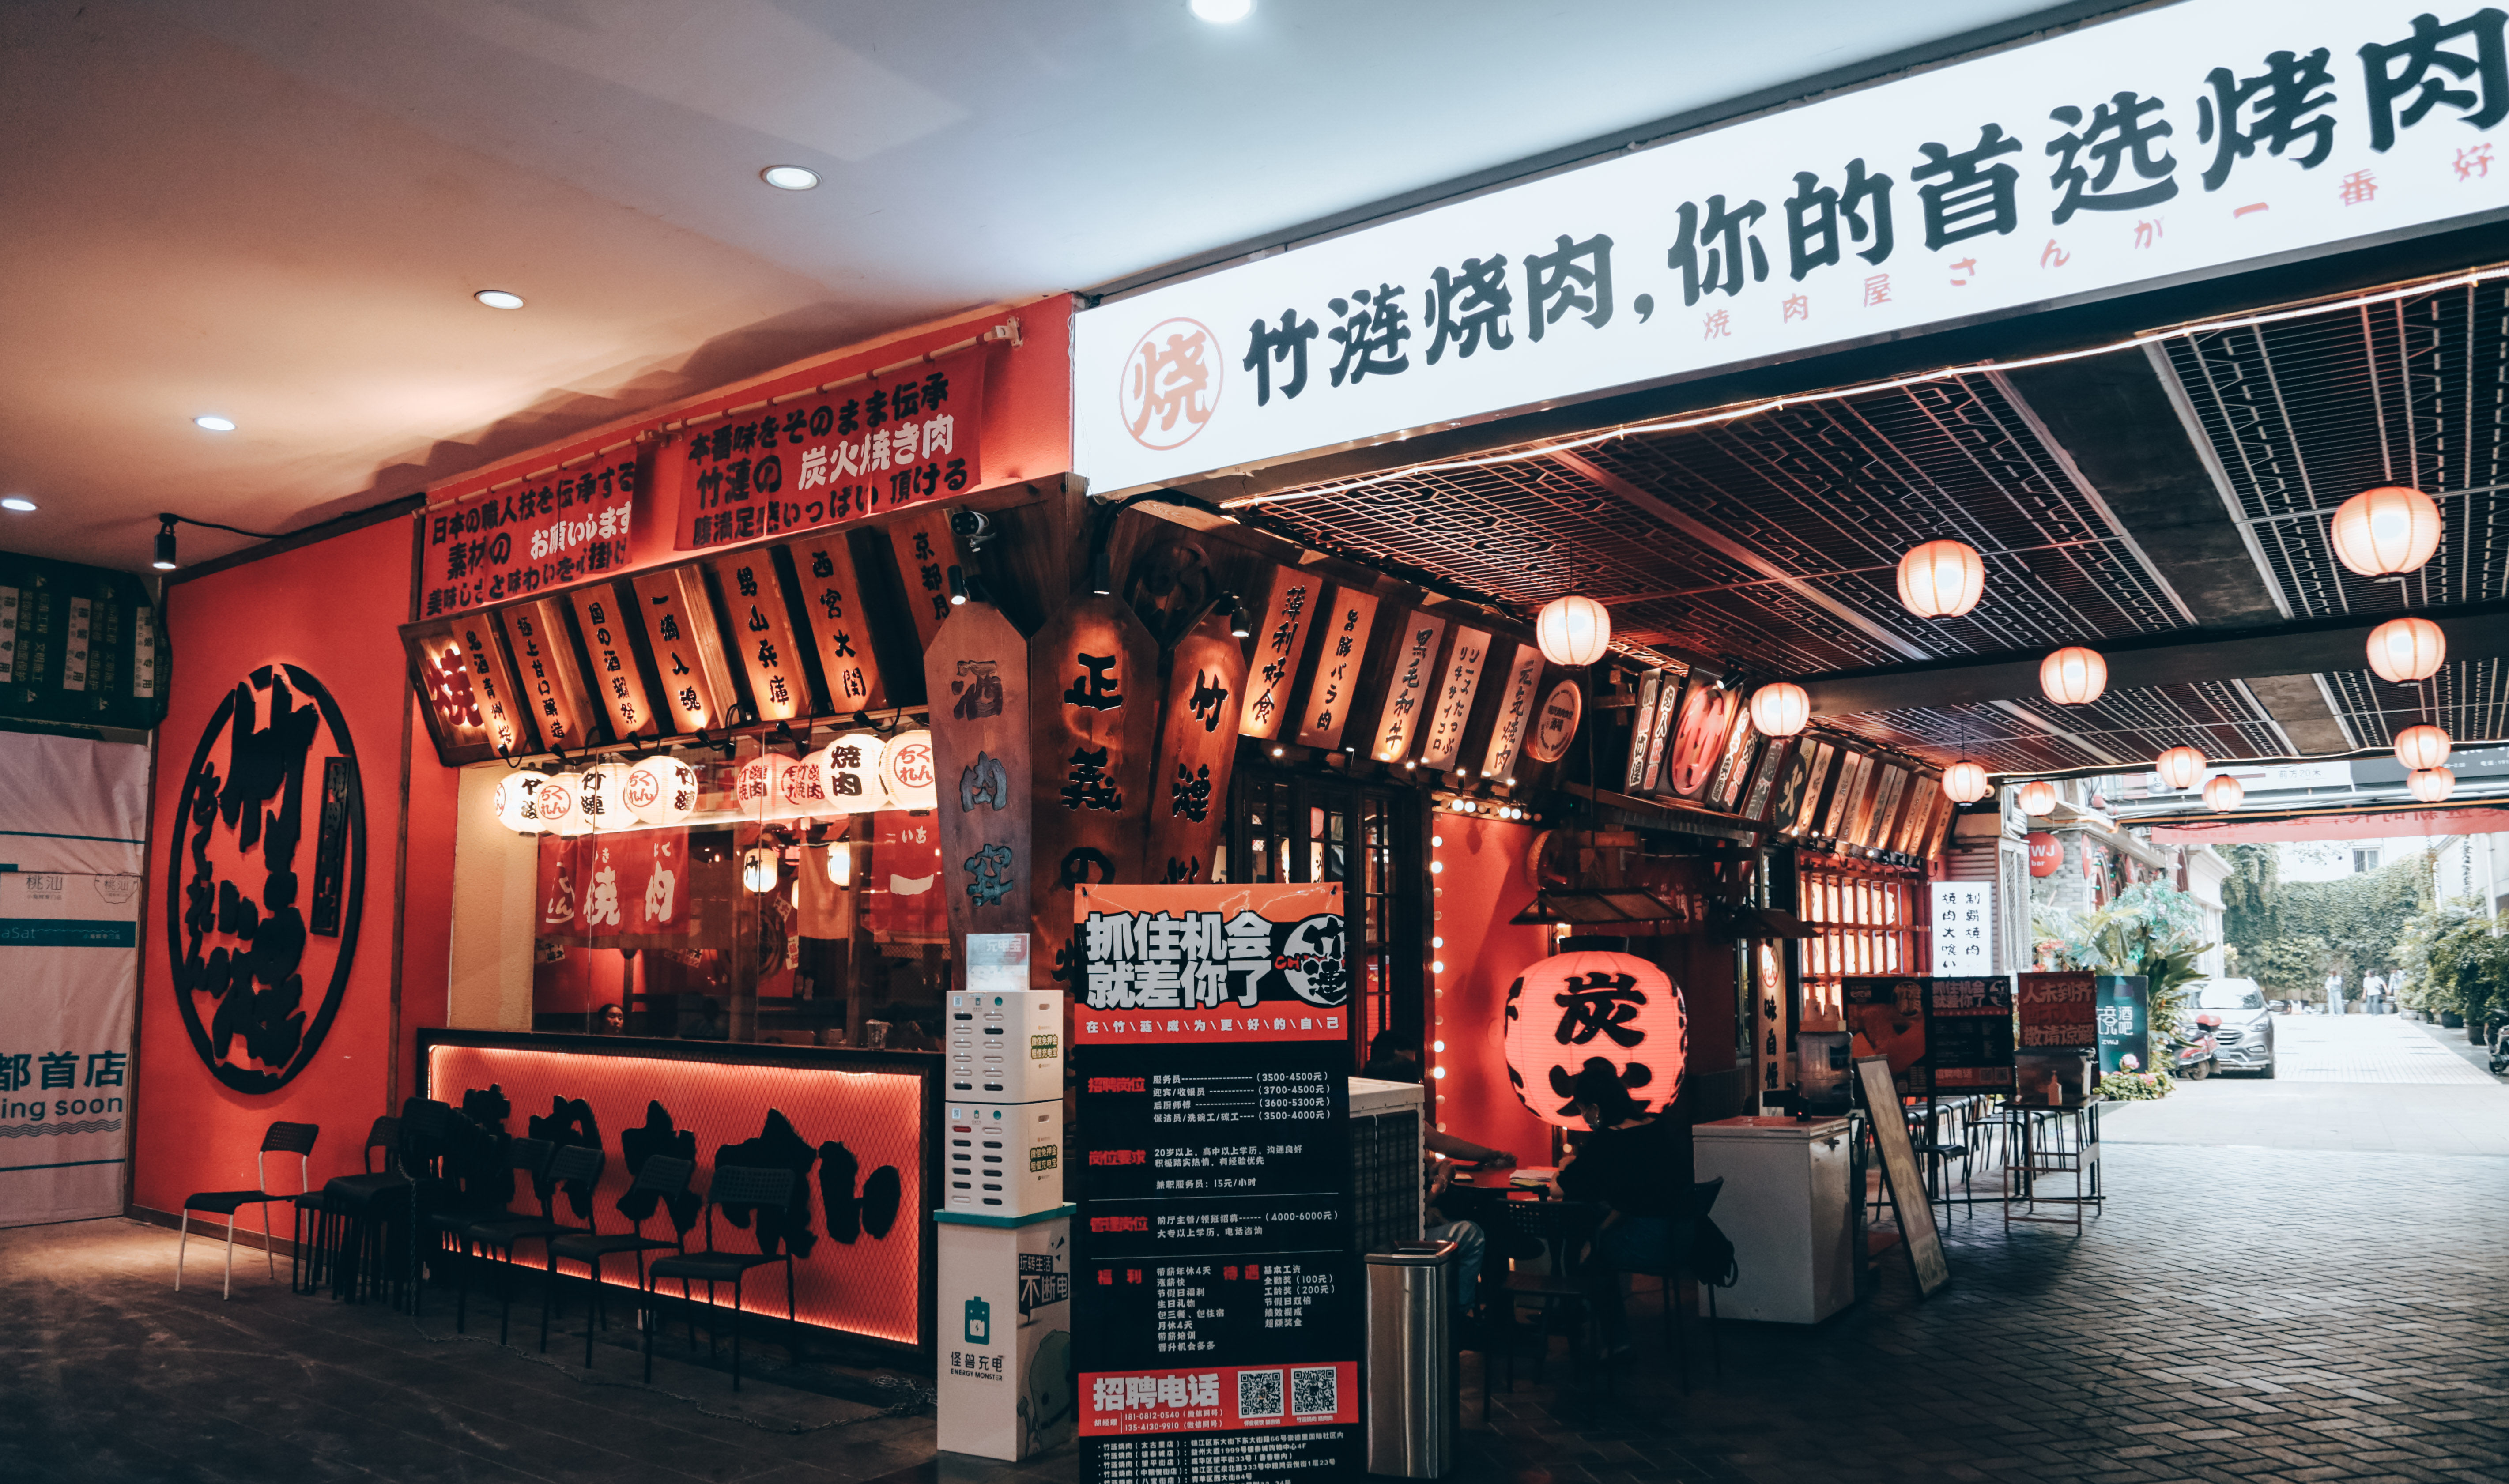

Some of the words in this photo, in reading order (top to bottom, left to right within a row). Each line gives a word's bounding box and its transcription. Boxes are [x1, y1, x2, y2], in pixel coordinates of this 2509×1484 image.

[799, 414, 954, 490] 炭火焼き肉
[737, 566, 789, 705] 男山兵庫
[652, 595, 701, 711] 一滴入魂
[831, 745, 862, 796] 焼肉
[2030, 845, 2056, 857] WJ
[1087, 911, 1272, 960] 抓住机会
[1087, 960, 1271, 1008] 就差你了
[2023, 981, 2094, 1004] 人未到齐
[1032, 1035, 1058, 1047] 微信免押金
[2024, 1024, 2095, 1045] 敬请谅解
[55, 1097, 122, 1117] soon
[1031, 1146, 1057, 1159] 微信免押金
[1020, 1255, 1051, 1272] 玩转生活
[1264, 1265, 1301, 1275] 基本工资
[1020, 1274, 1068, 1307] 不断电
[1157, 1299, 1196, 1309] 生日礼物
[1158, 1321, 1193, 1330] 月休4天
[951, 1351, 1003, 1373] 怪兽充电
[951, 1369, 973, 1377] ENERGY
[1093, 1373, 1219, 1411] 招聘电话
[1125, 1411, 1180, 1420] 181-0812-0540
[1125, 1422, 1179, 1431] 135-4130-9910
